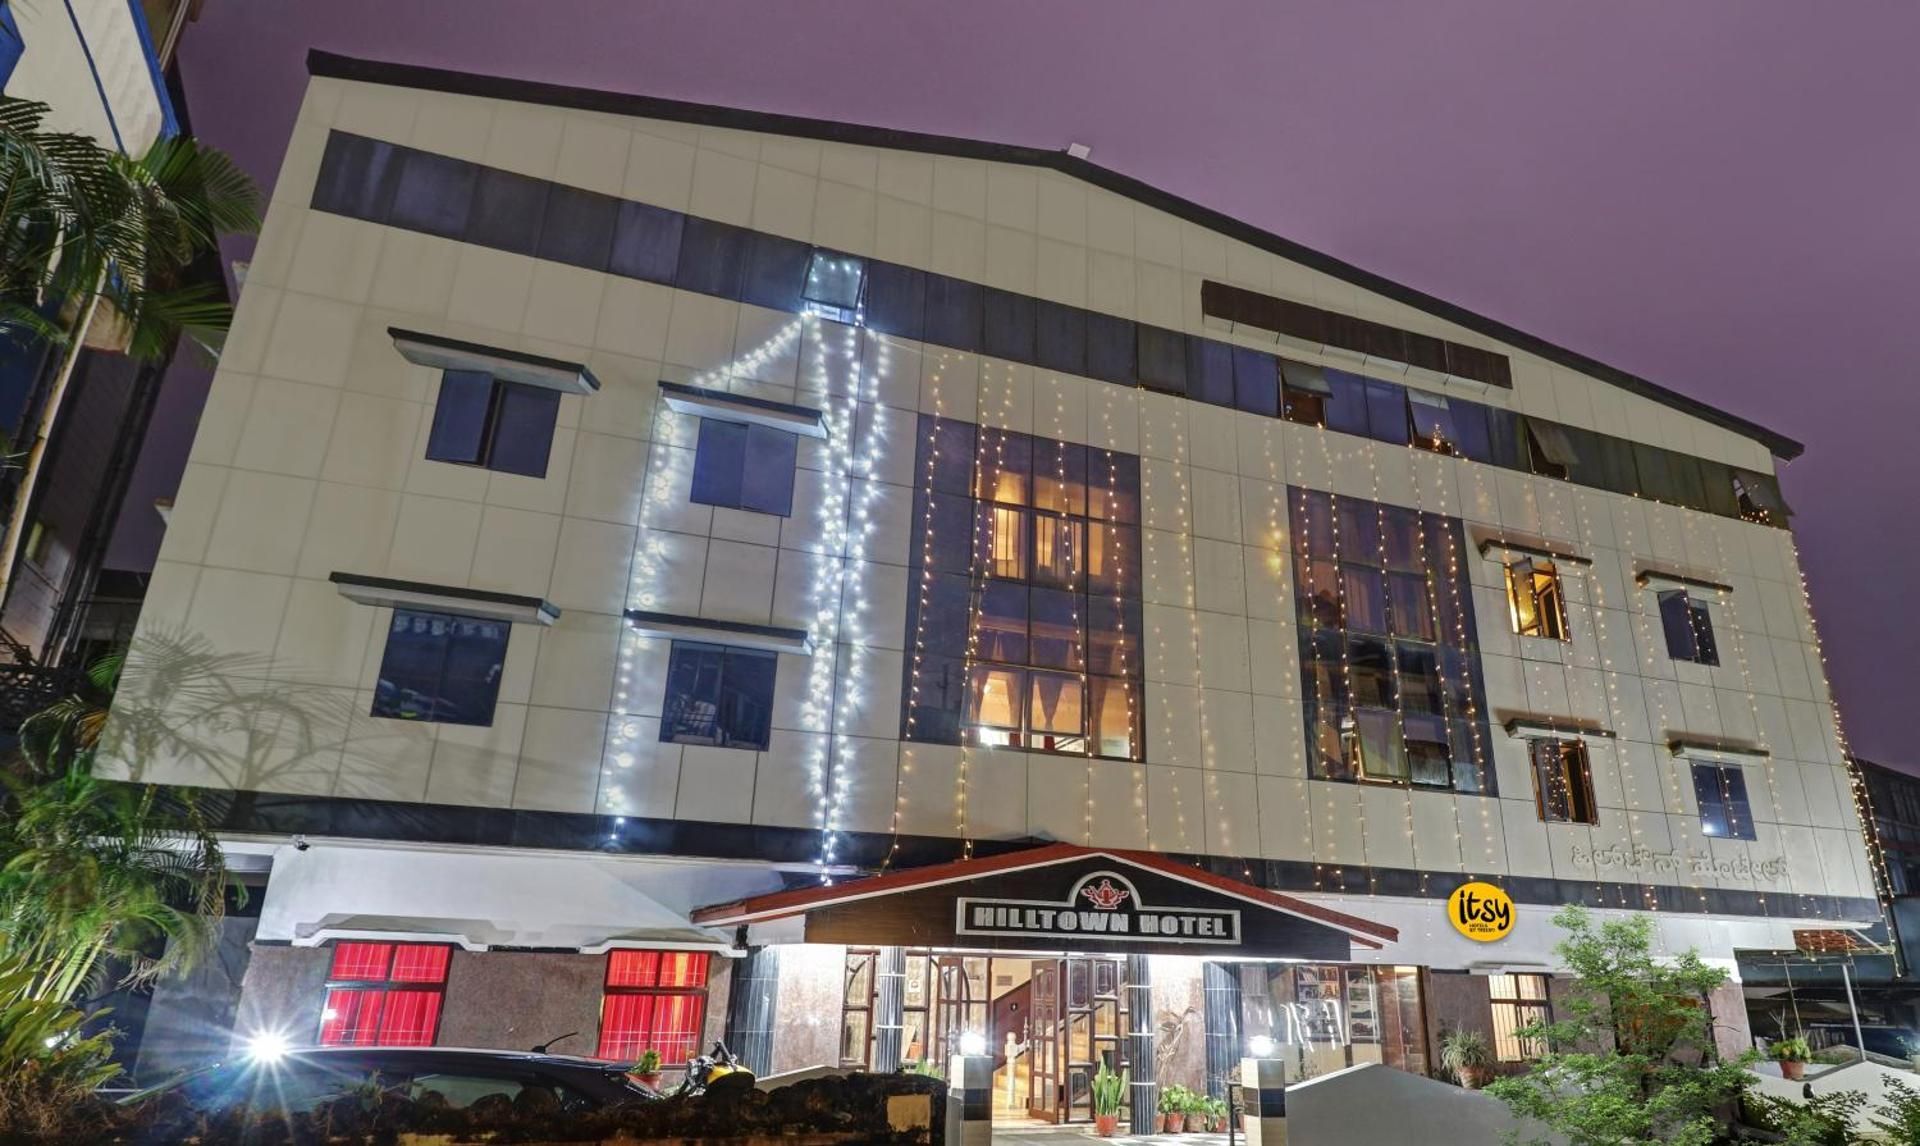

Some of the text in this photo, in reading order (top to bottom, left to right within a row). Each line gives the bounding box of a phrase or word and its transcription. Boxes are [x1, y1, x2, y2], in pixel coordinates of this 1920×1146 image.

[973, 906, 1227, 937] HILLTOWN HOTEL
[1459, 890, 1510, 931] itsy
